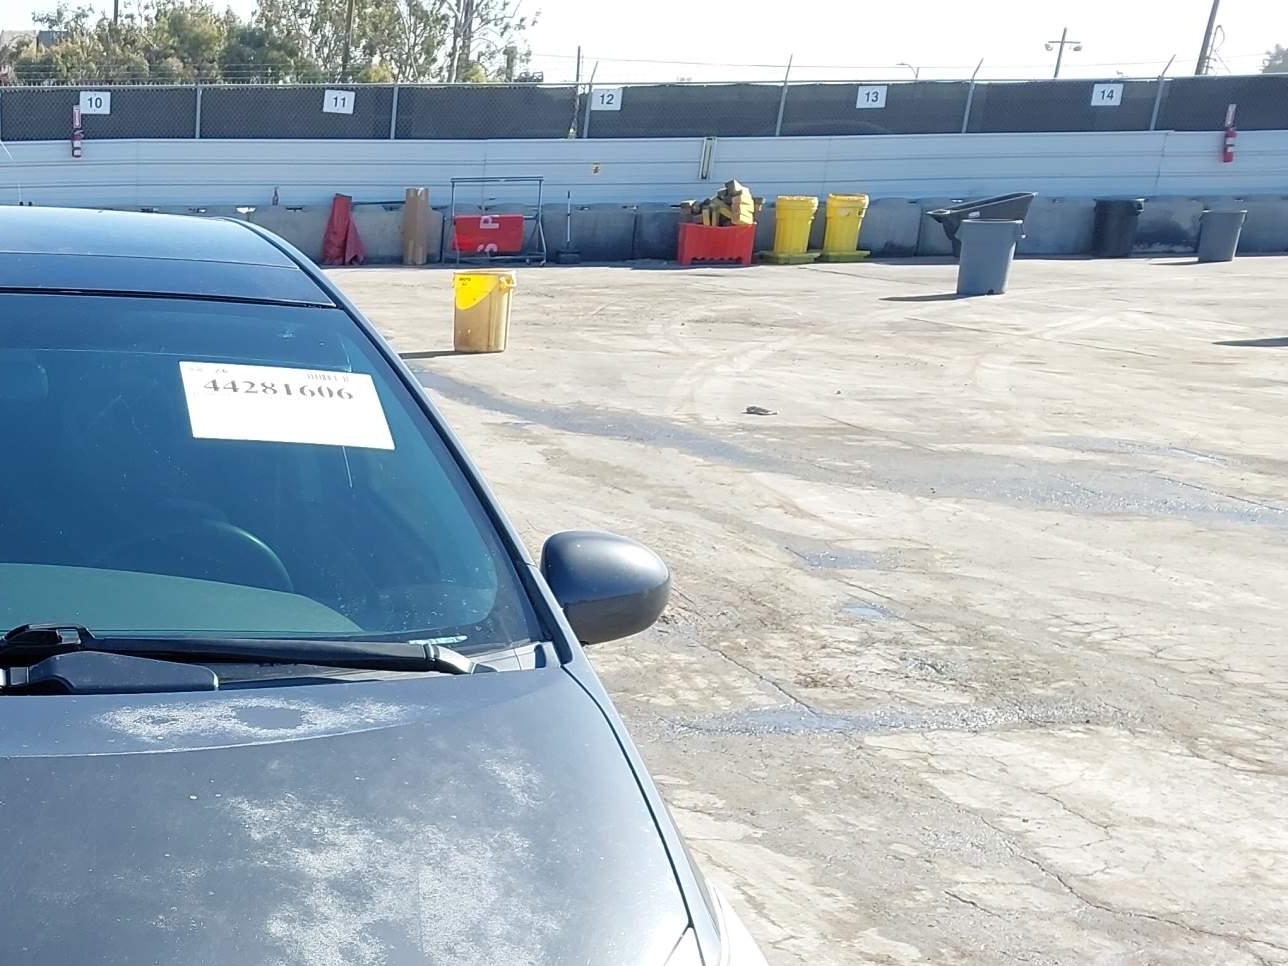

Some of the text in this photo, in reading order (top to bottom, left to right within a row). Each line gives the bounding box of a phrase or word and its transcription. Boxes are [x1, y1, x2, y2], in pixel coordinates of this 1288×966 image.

[332, 95, 346, 108] 11
[599, 93, 614, 105] 12
[865, 90, 880, 103] 13
[1101, 89, 1114, 101] 14
[87, 96, 103, 109] 10
[203, 378, 355, 400] 44281606
